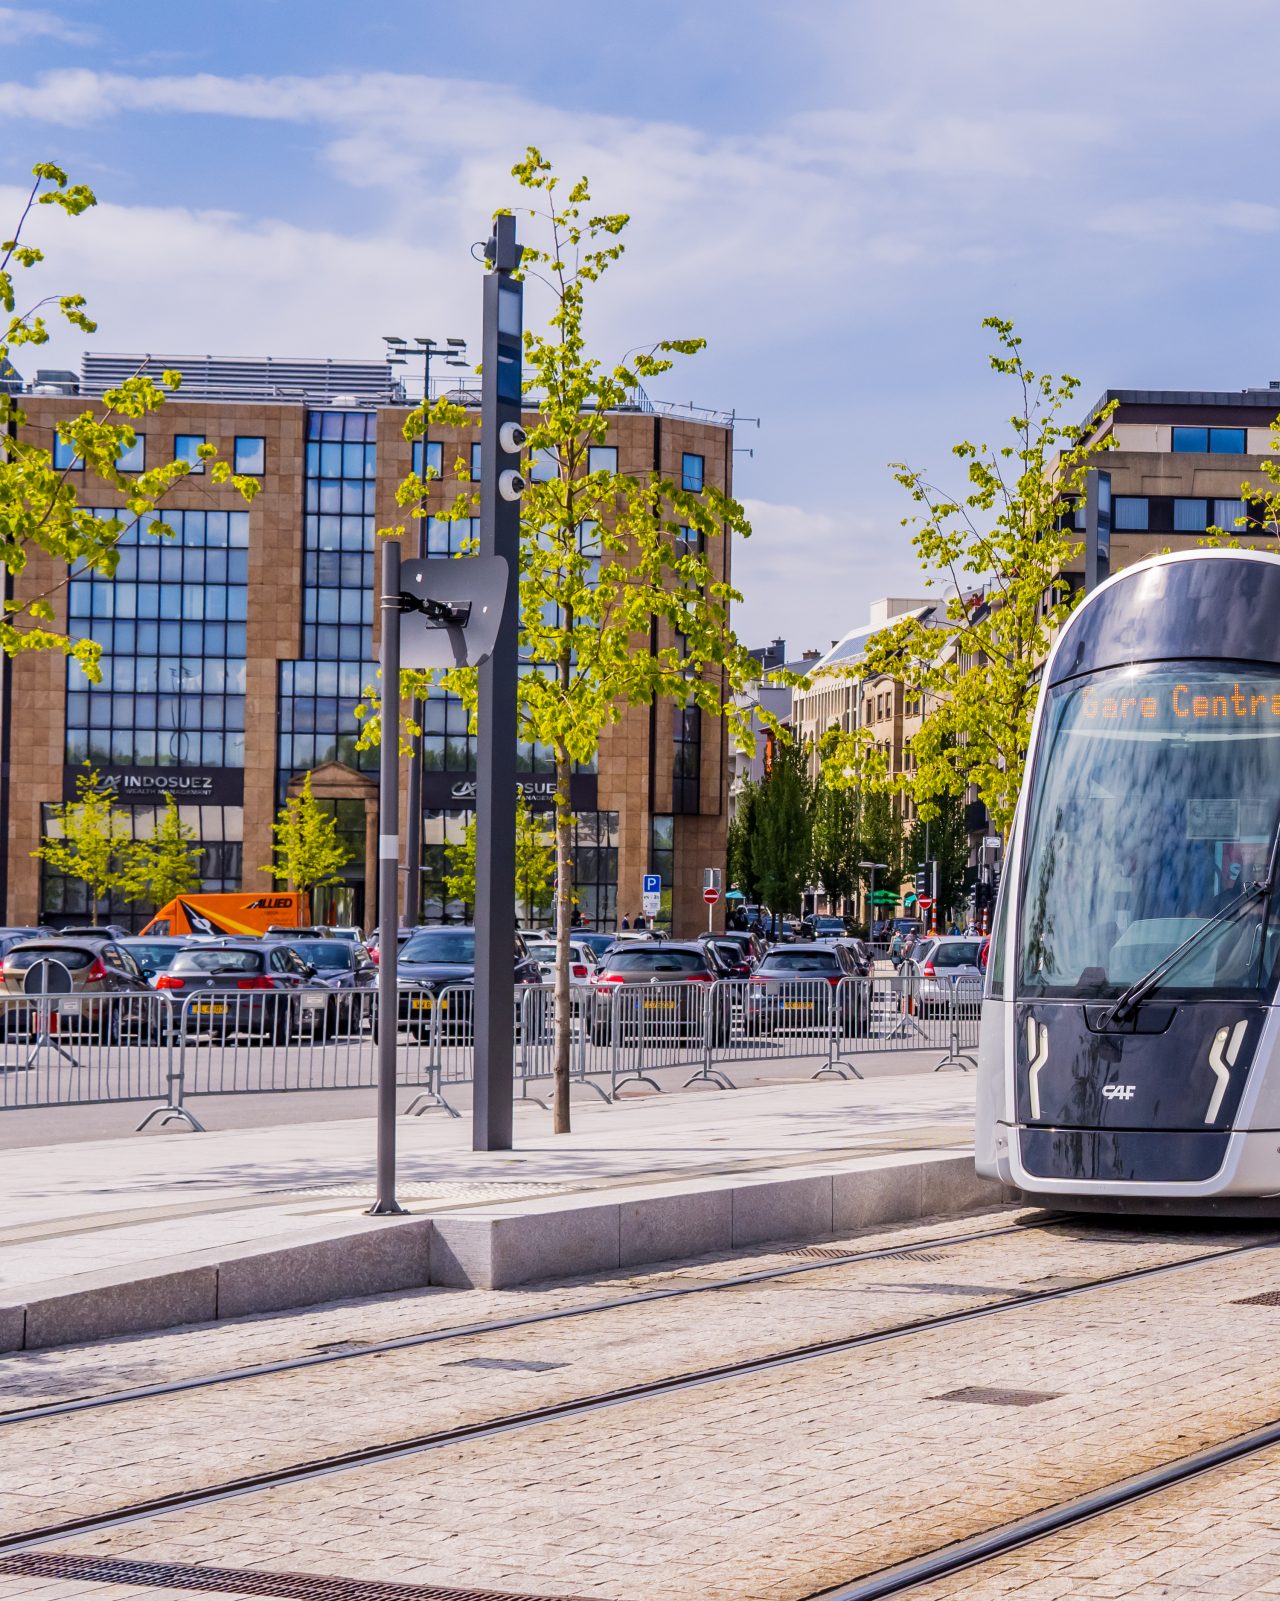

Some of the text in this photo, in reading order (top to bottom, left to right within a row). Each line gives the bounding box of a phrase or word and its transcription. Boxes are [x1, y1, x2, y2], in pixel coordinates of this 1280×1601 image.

[1082, 687, 1157, 718] Gare
[124, 775, 212, 788] INDOSUEZ
[647, 877, 656, 891] P
[247, 898, 293, 909] ALLIED
[1102, 1085, 1136, 1100] CAF
